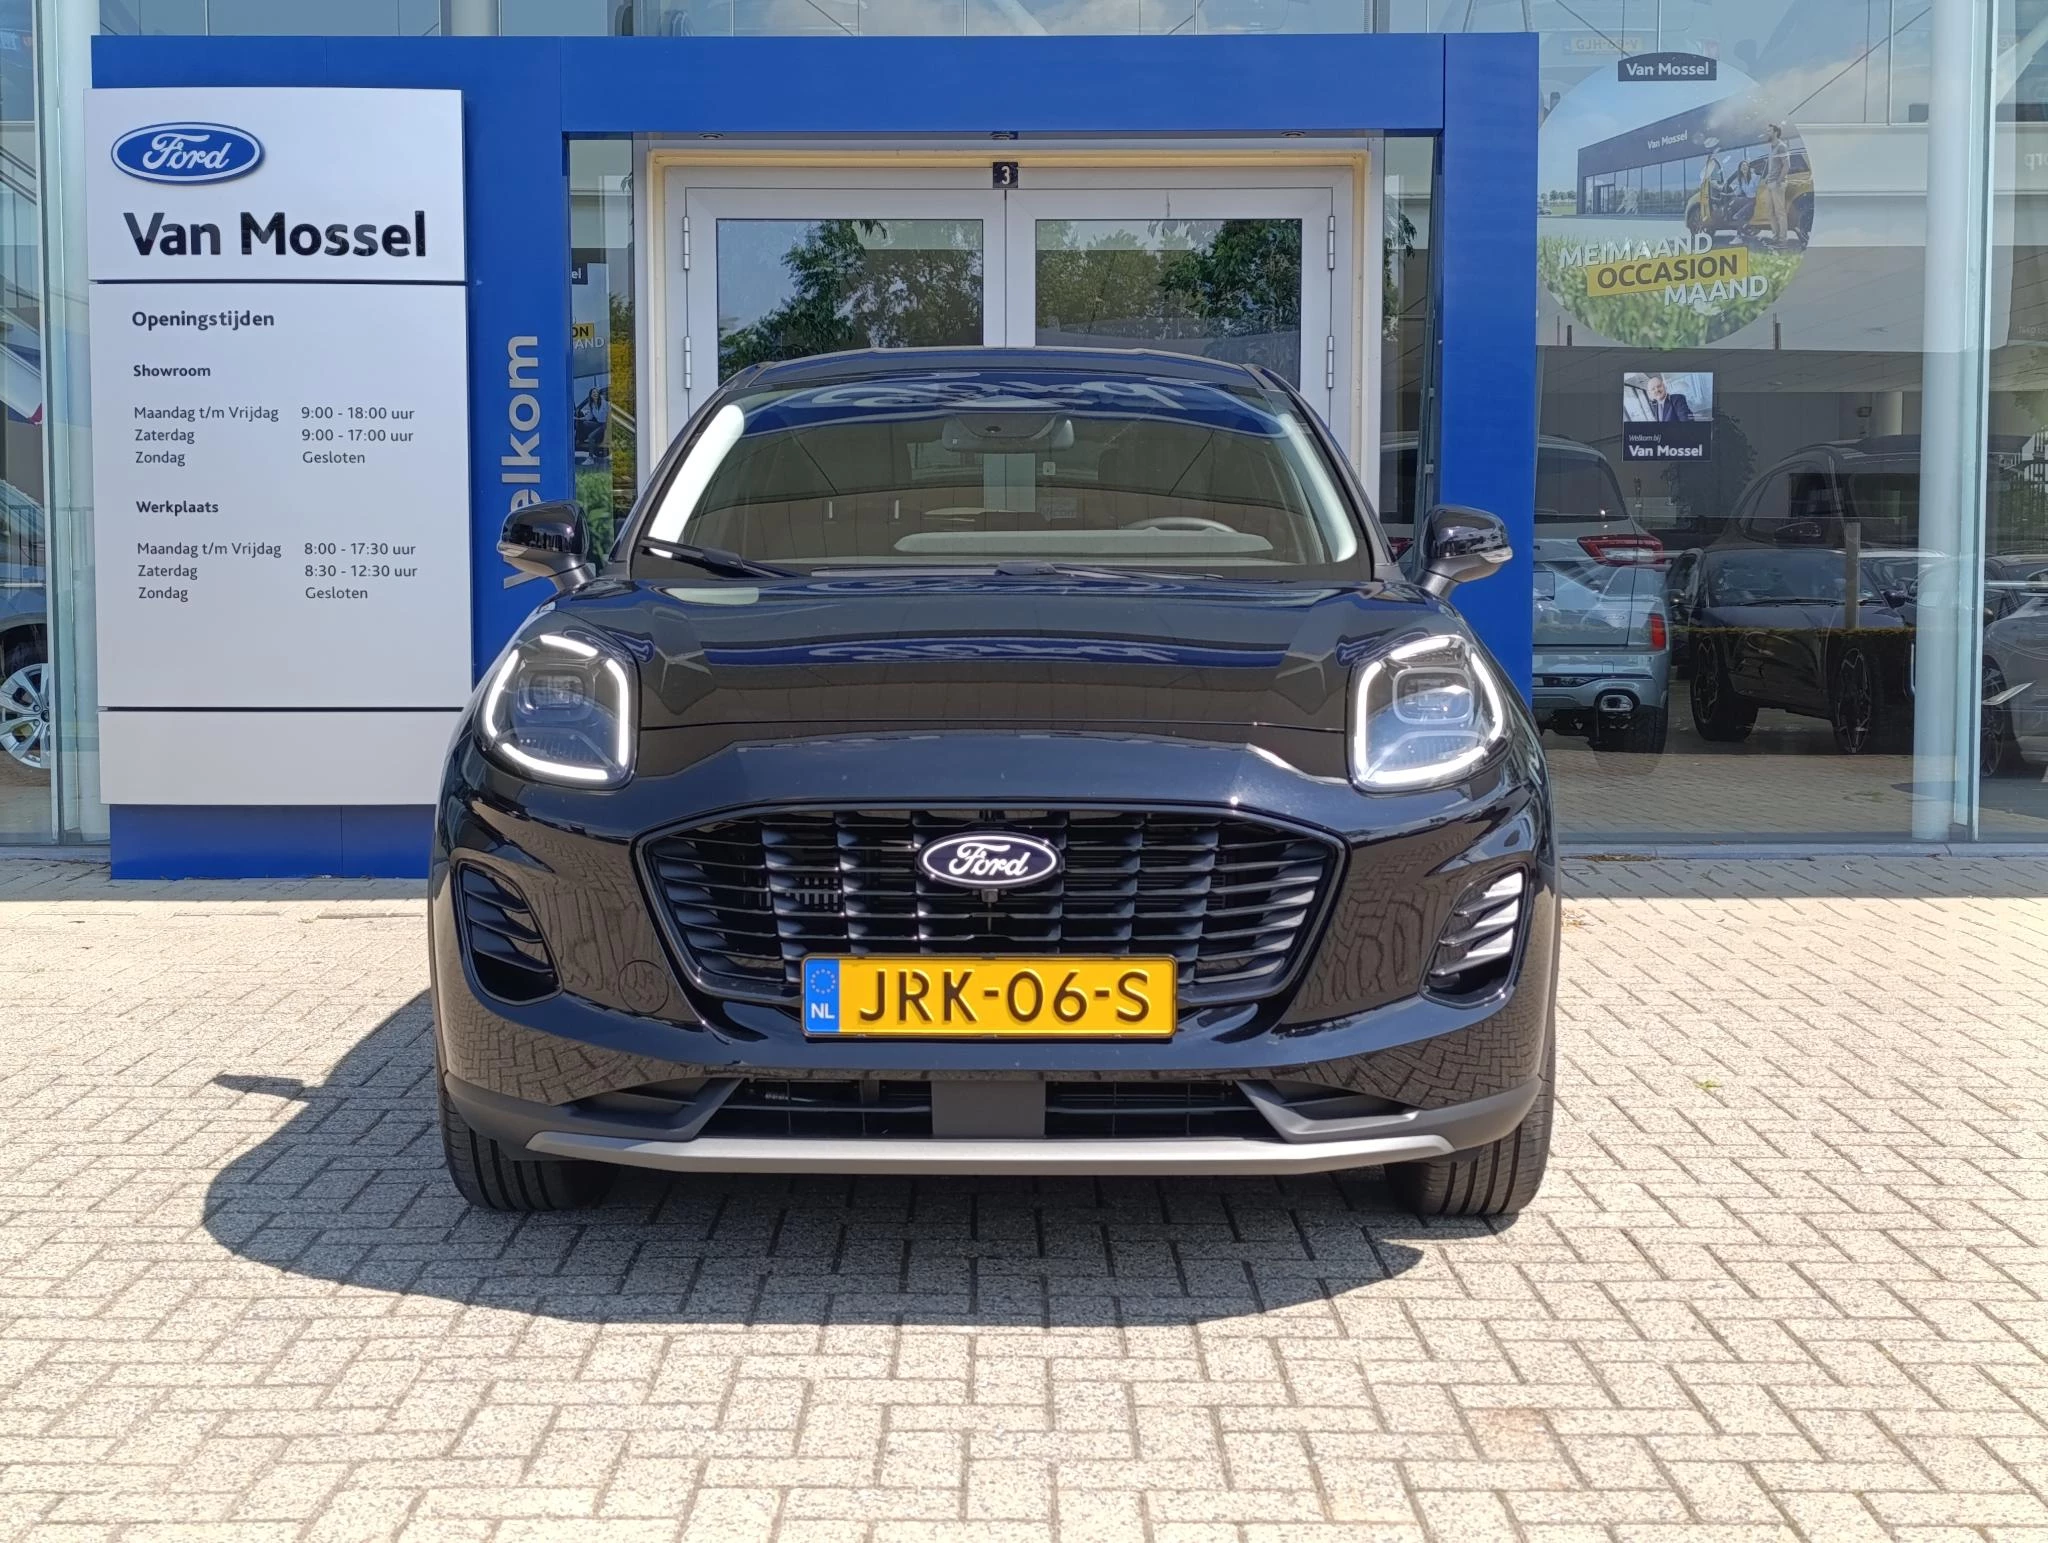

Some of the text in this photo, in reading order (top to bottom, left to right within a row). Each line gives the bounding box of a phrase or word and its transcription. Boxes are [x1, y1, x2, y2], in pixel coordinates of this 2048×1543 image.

[1626, 62, 1709, 77] Van Mossel
[1647, 130, 1688, 150] Van Mossel
[142, 133, 234, 172] Ford
[1001, 165, 1011, 185] 3
[123, 210, 426, 257] Van Mossel
[1597, 254, 1738, 289] OCCASION
[1664, 275, 1769, 307] MAAND
[132, 310, 275, 331] Openingstijden
[133, 364, 211, 377] Showroom
[134, 406, 279, 423] Maandag t/m Vrijdag
[301, 407, 333, 419] 9:00
[348, 407, 387, 420] 18:00
[392, 409, 415, 420] uur
[135, 429, 195, 445] Zaterdag
[301, 429, 334, 442] 9:00
[349, 429, 386, 442] 17:00
[391, 432, 414, 442] uur
[1653, 434, 1662, 444] bij
[302, 451, 366, 464] Gesloten
[1629, 444, 1703, 457] Van Mossel
[135, 451, 185, 467] Zondag
[500, 335, 543, 590] elkom
[136, 501, 219, 516] Werkplaats
[137, 542, 282, 559] Maandag t/m Vrijdag
[304, 542, 336, 555] 8:00
[350, 542, 388, 556] 17:30
[393, 545, 416, 556] uur
[138, 564, 198, 580] Zaterdag
[305, 565, 337, 577] 8:30
[351, 565, 390, 577] 12:30
[394, 567, 418, 578] uur
[138, 586, 189, 602] Zondag
[305, 586, 368, 600] Gesloten
[947, 842, 1033, 878] Ford
[859, 970, 1152, 1023] JRK-06-S
[810, 1003, 836, 1020] NL
